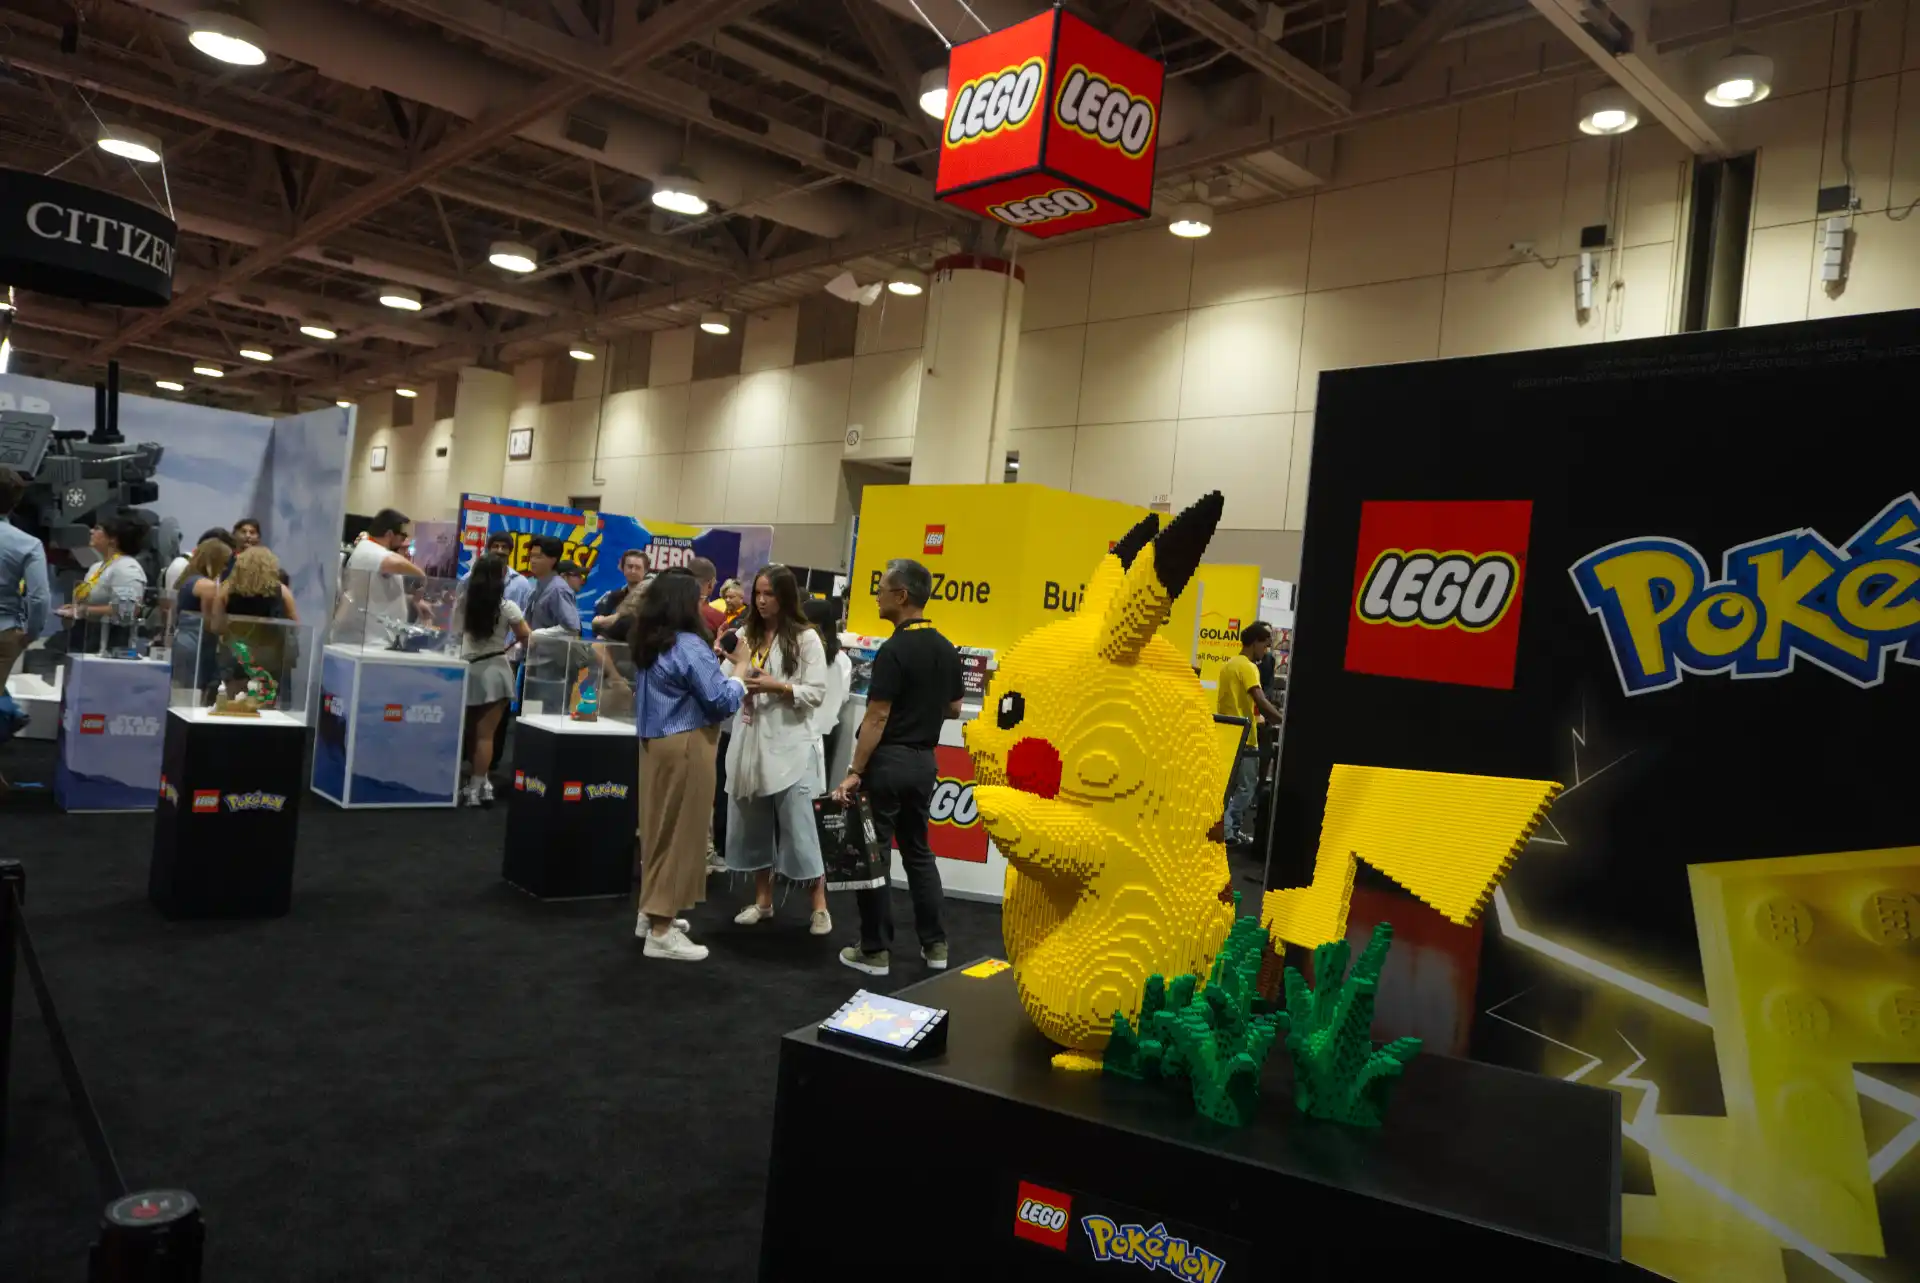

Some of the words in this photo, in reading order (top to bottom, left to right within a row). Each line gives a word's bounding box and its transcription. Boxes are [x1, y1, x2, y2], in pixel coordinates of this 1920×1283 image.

[948, 61, 1043, 145] LEGO
[1057, 68, 1153, 155] LEGO
[990, 189, 1094, 226] LEGO
[26, 202, 175, 277] CITIZEN
[653, 537, 673, 546] BUILD
[674, 538, 692, 547] YOUR
[925, 533, 944, 546] LEGO
[930, 573, 991, 604] Zone
[1359, 551, 1517, 630] LEGO
[929, 779, 979, 825] GO
[1019, 1199, 1067, 1232] LEGO
